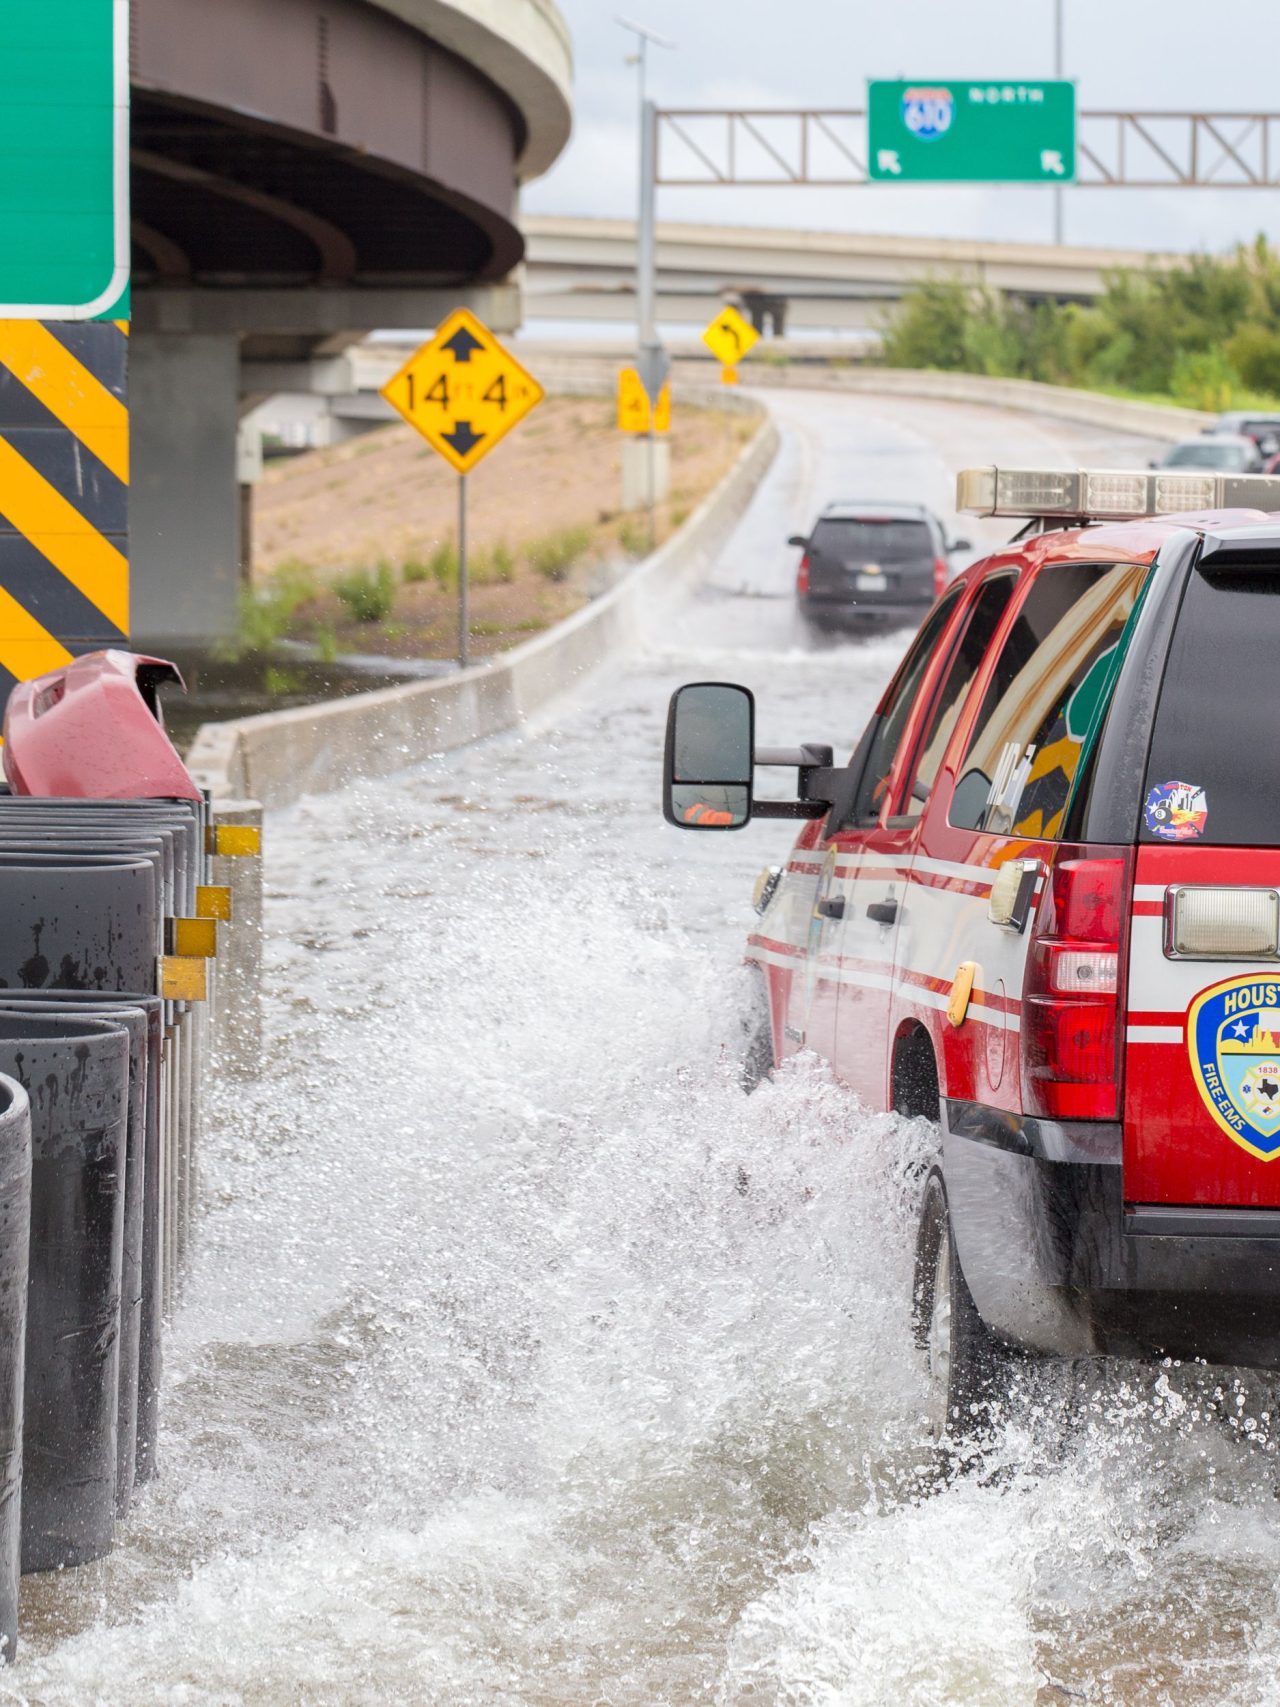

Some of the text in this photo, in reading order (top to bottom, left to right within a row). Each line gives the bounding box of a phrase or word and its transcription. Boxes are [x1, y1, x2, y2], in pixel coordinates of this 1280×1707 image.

[904, 101, 953, 132] 610
[407, 374, 450, 411] 14
[482, 374, 507, 411] 4
[1258, 1066, 1278, 1074] 1838
[1203, 1062, 1246, 1131] FIRE-EMS
